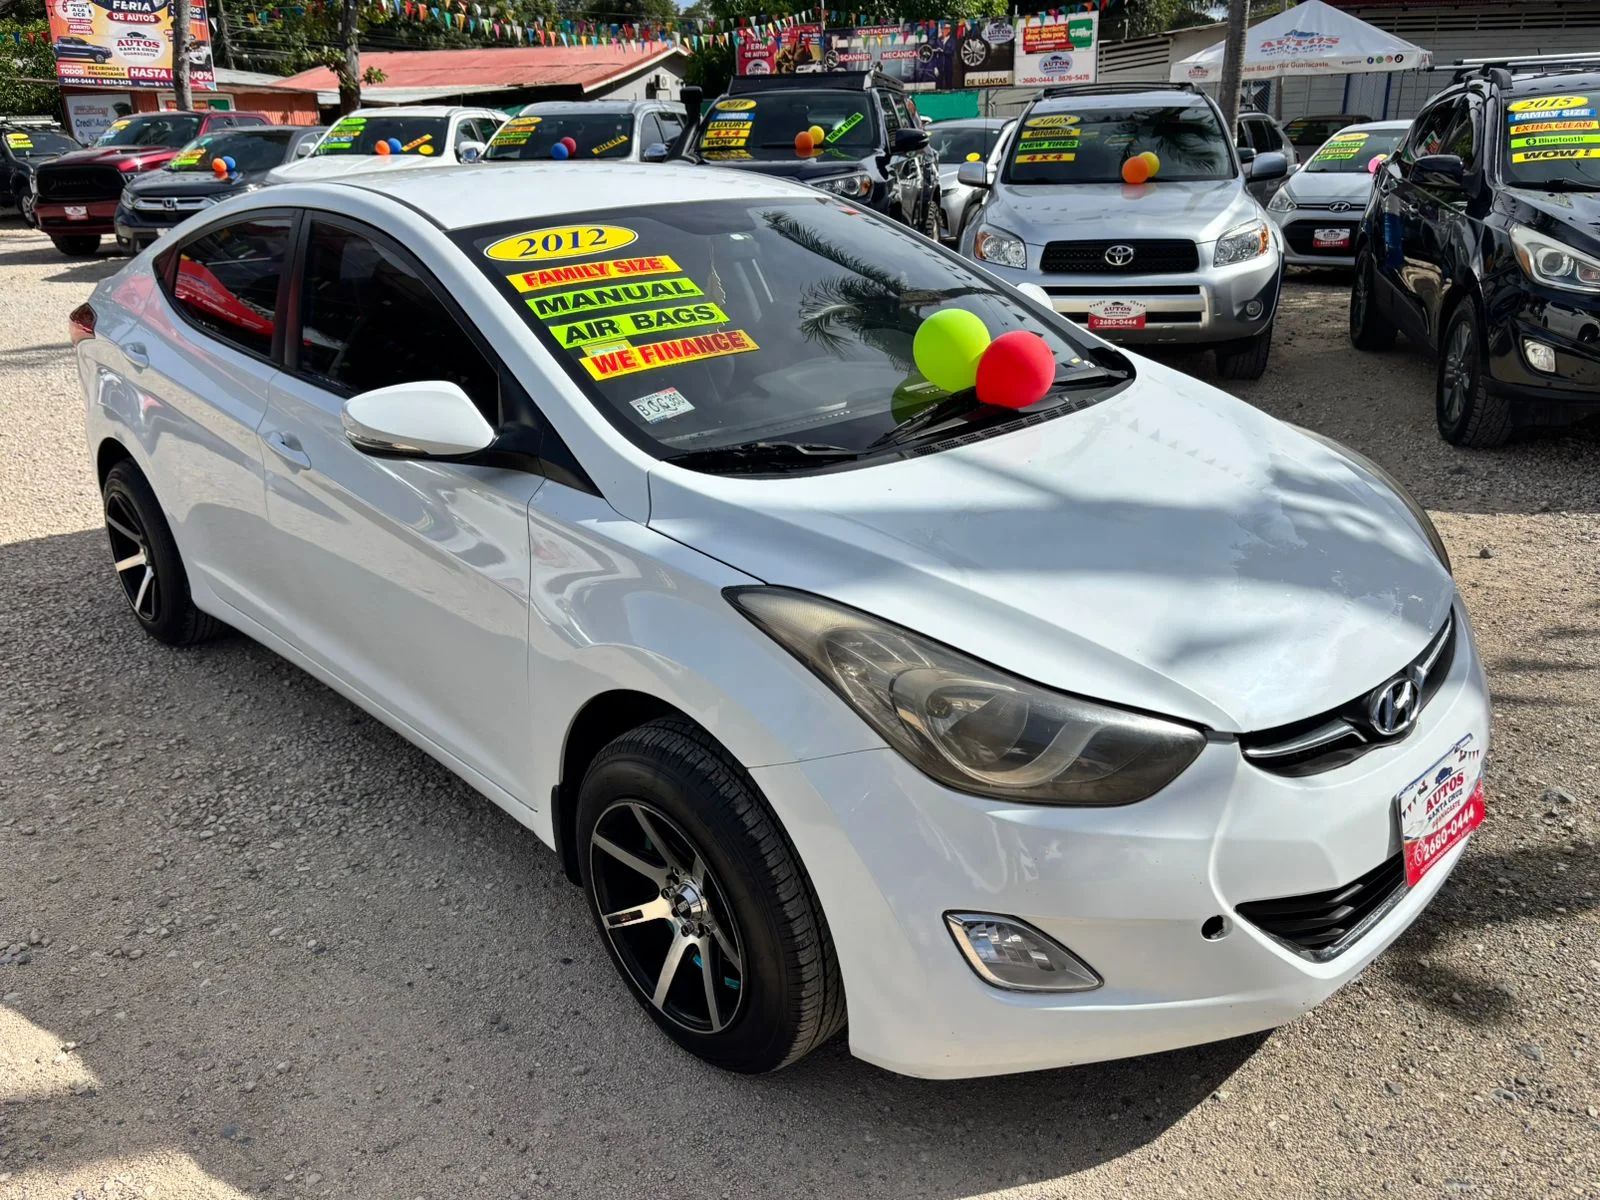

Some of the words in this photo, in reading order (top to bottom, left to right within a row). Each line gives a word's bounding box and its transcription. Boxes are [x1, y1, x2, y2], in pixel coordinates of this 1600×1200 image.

[112, 0, 152, 12] FERIA
[127, 13, 156, 22] AUTOS
[117, 39, 160, 49] AUTOS
[130, 68, 168, 78] HASTA
[1522, 97, 1575, 110] 2015
[1515, 110, 1560, 121] FAMILY
[1561, 108, 1591, 117] SIZE
[711, 121, 747, 129] LUXURY
[827, 126, 844, 141] NEW
[842, 114, 861, 129] TIRES
[1034, 116, 1072, 127] 2008
[1515, 123, 1552, 132] EXTRA
[1555, 121, 1592, 129] CLEAN
[1029, 129, 1073, 137] AUTOMATIC
[1048, 140, 1076, 148] TIRES
[1538, 136, 1584, 144] Bluetooth
[1523, 150, 1578, 160] WOW
[517, 228, 608, 257] 2012
[522, 263, 609, 287] FAMILY
[612, 257, 665, 274] SIZE
[535, 281, 695, 315] MANUAL
[566, 319, 621, 345] AIR
[630, 305, 717, 330] BAGS
[591, 350, 637, 374] WE
[638, 331, 747, 364] FINANCE
[1425, 771, 1464, 815] AUTOS
[1427, 799, 1448, 821] SANTA
[1448, 787, 1463, 803] CRUZ
[1424, 803, 1475, 861] 2680-0444
